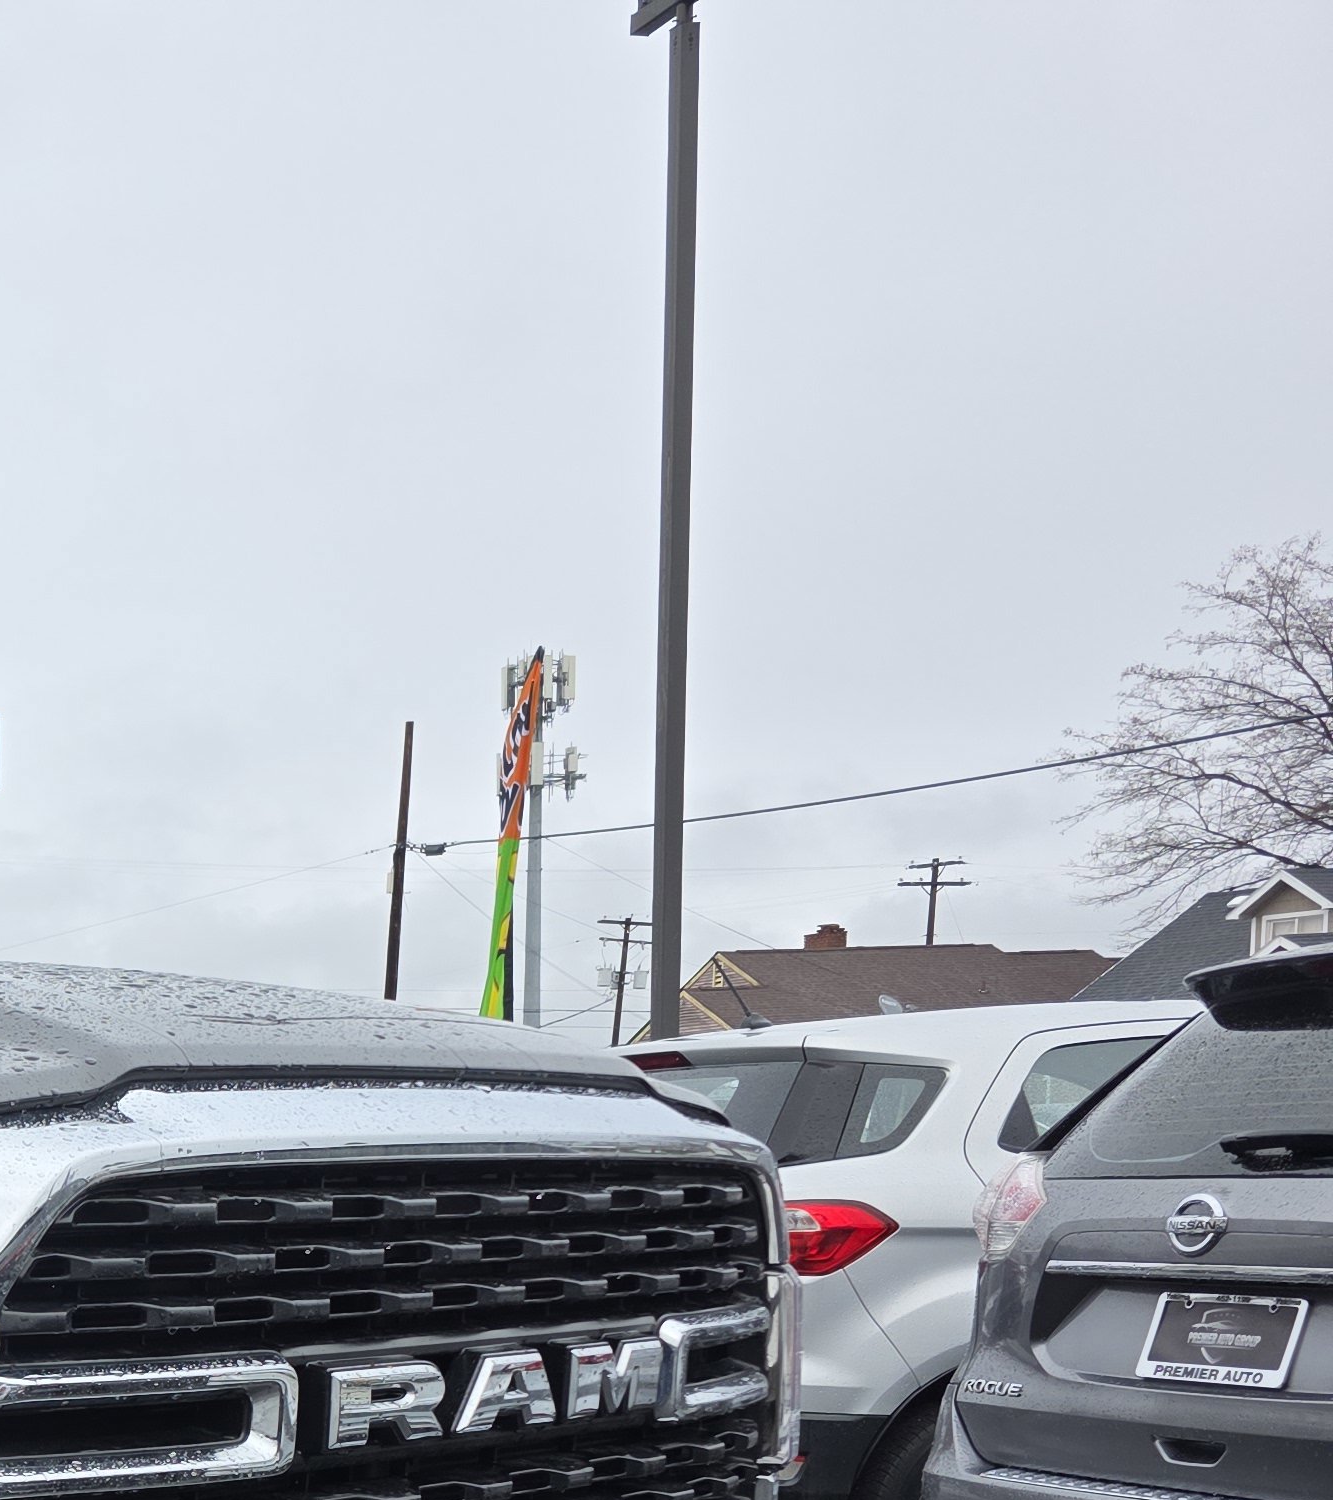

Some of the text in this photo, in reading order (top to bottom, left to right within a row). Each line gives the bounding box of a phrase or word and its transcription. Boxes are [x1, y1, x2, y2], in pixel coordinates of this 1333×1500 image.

[1168, 1220, 1217, 1231] NISSAN
[1153, 1364, 1264, 1384] PREMIER AUTO
[326, 1336, 664, 1450] RAM
[964, 1379, 1023, 1397] ROGUE
